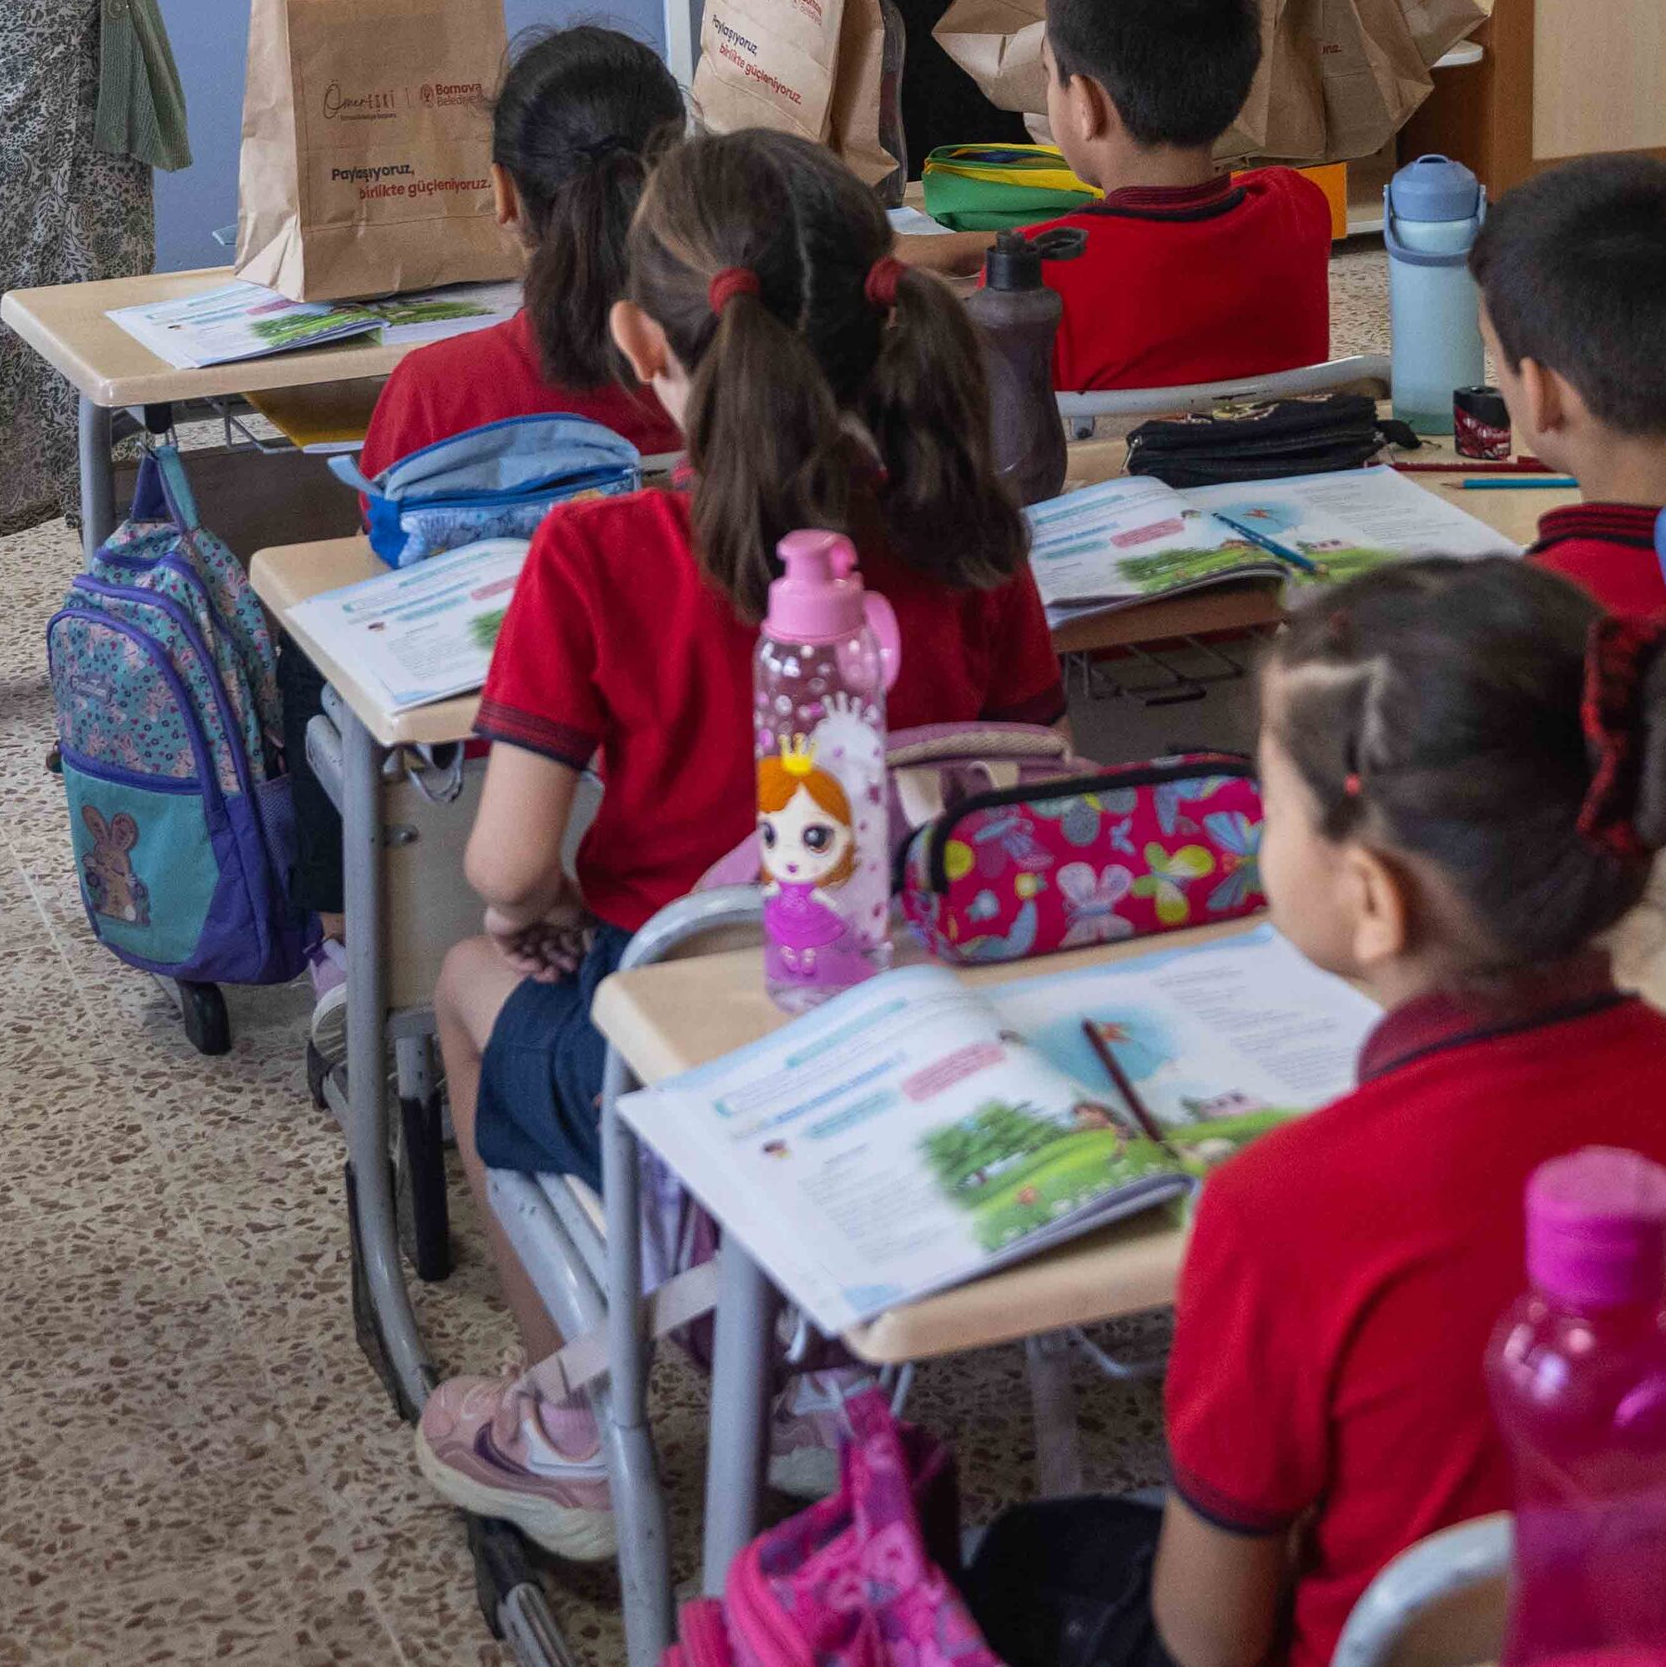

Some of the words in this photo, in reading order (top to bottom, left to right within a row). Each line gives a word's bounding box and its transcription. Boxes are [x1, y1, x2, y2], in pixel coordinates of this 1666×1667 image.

[712, 14, 758, 57] Paylaşıyoruz,
[719, 42, 746, 69] birlikte
[745, 59, 802, 106] güçleniyoruz.
[435, 82, 482, 96] Bornova
[331, 162, 415, 183] Paylaşıyoruz,
[359, 184, 405, 201] birlikte
[407, 177, 492, 198] güçleniyoruz.
